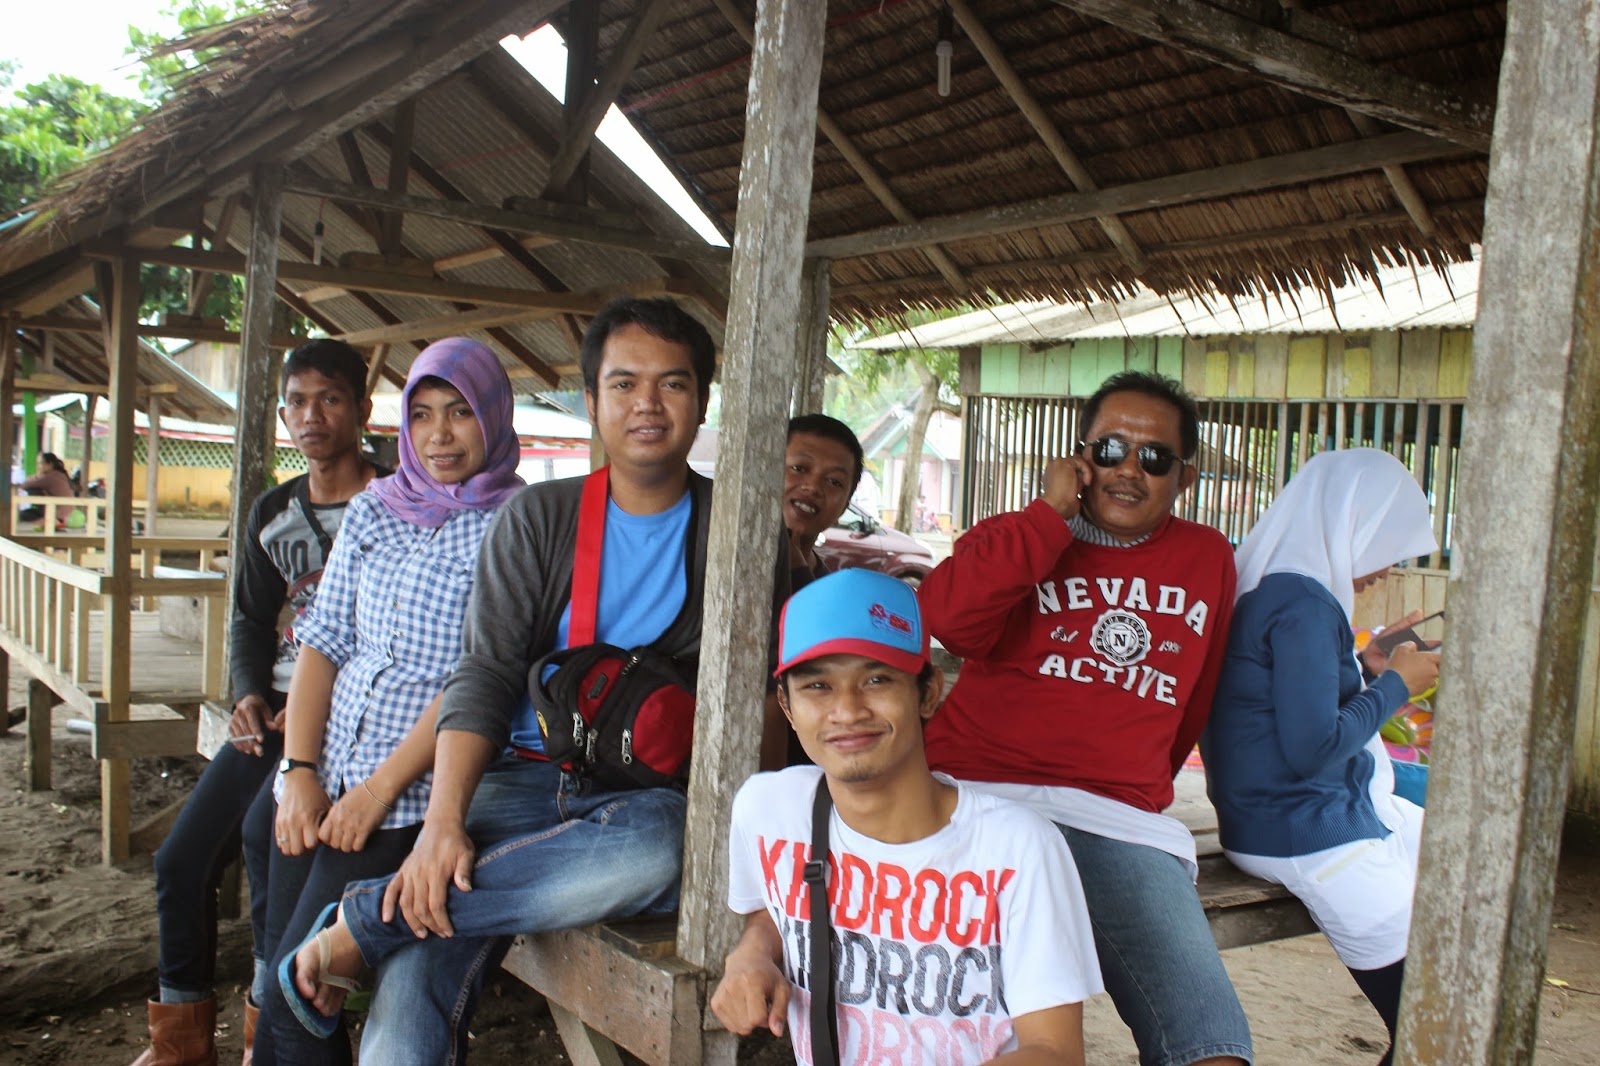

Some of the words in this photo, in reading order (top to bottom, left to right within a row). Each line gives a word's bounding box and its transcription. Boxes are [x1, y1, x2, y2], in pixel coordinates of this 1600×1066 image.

[1035, 576, 1209, 637] NEVADA
[1113, 633, 1127, 647] N
[1038, 654, 1177, 706] ACTIVE
